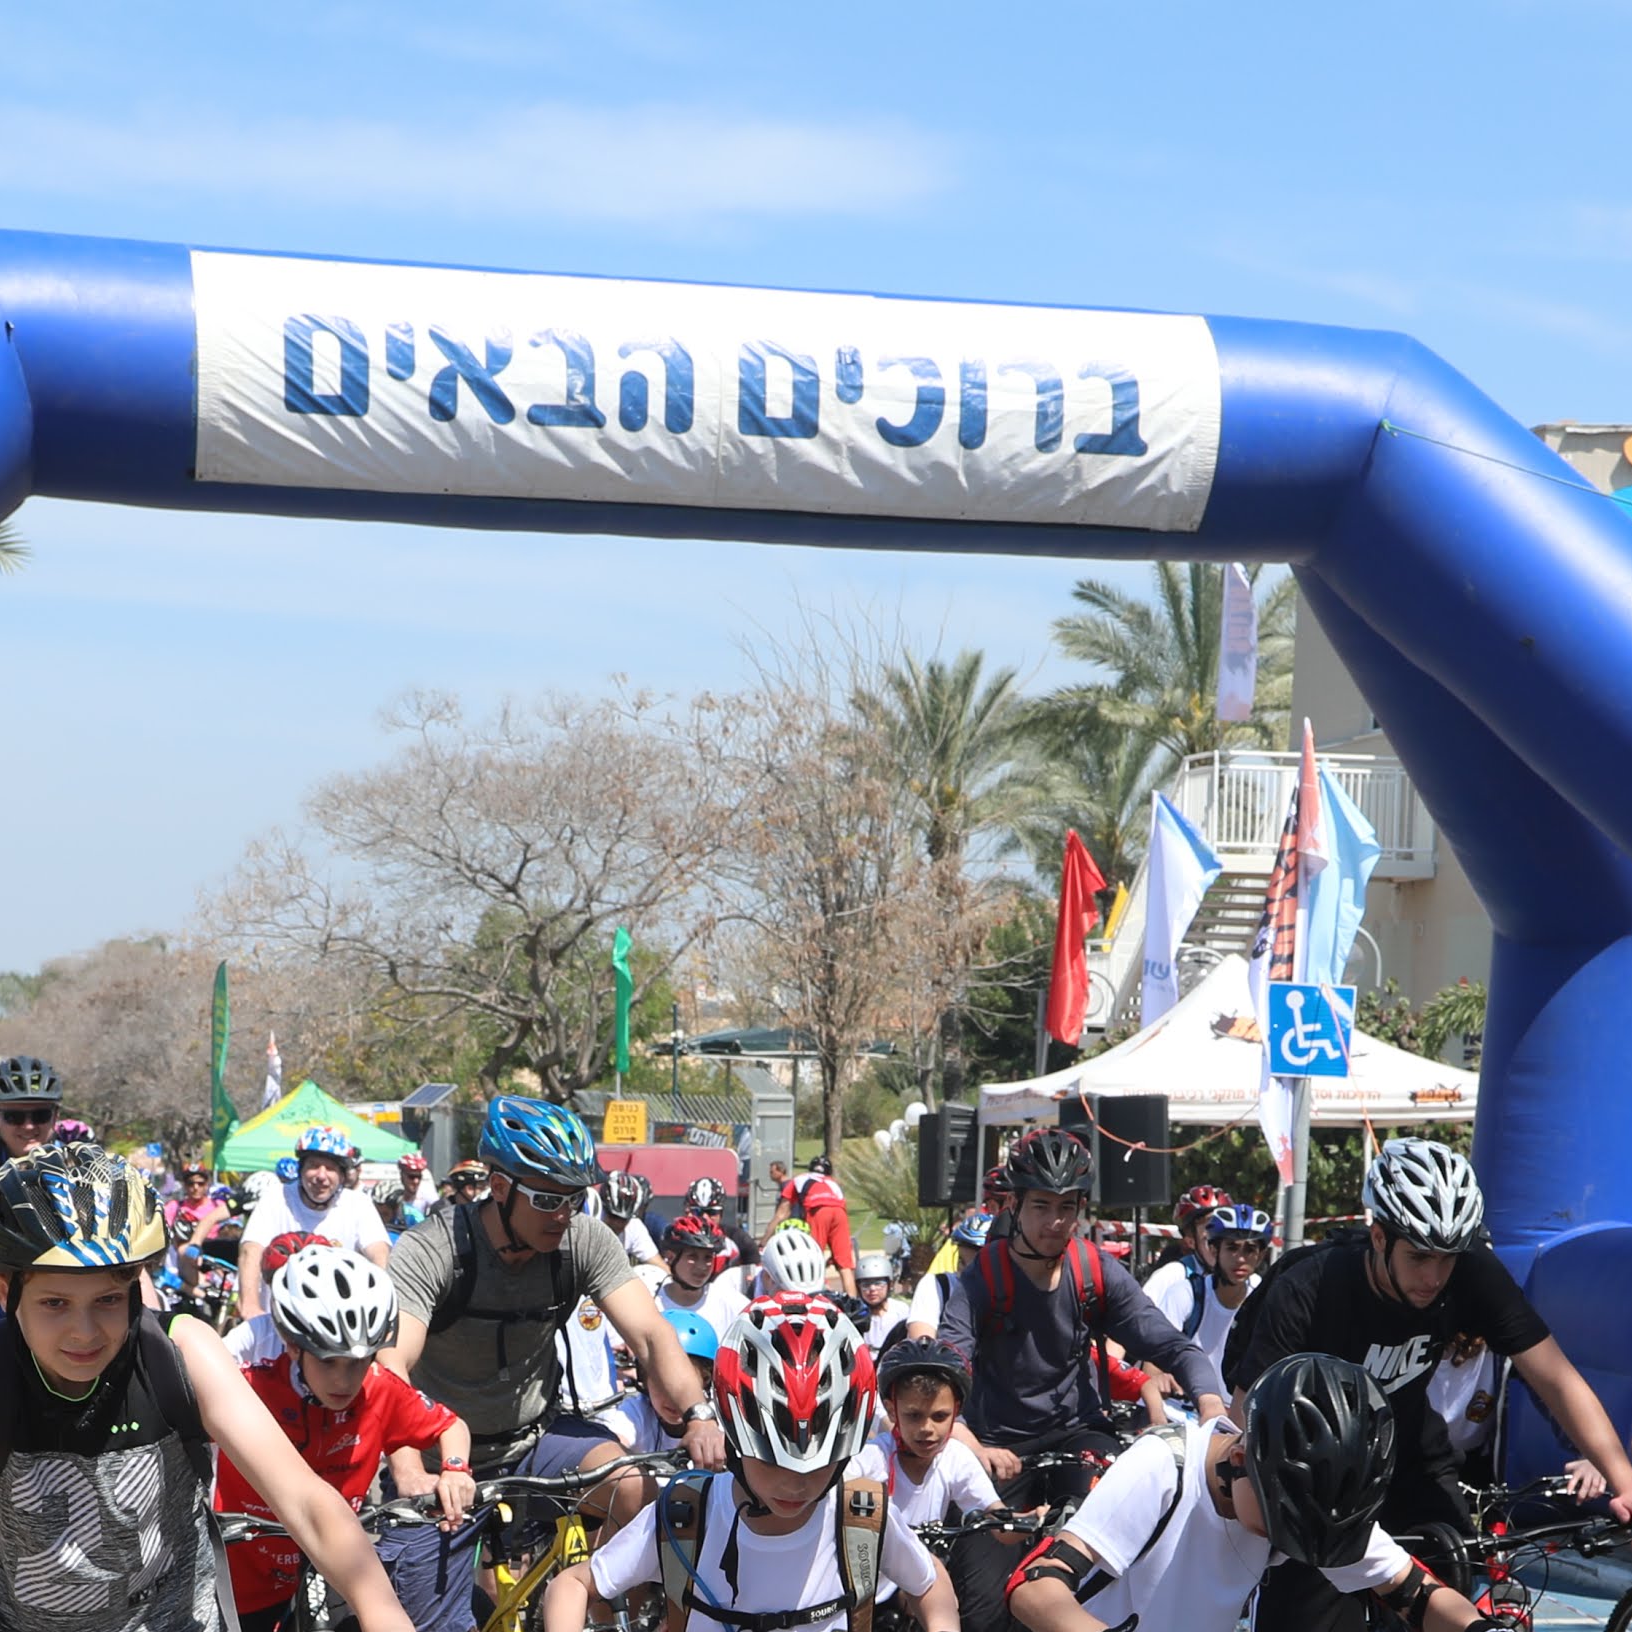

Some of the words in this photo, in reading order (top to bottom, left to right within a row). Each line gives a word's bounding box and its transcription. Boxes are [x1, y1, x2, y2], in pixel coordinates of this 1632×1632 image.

[283, 313, 696, 435] הבאים
[736, 340, 1147, 457] ברוכים
[1362, 1334, 1432, 1380] NIKE
